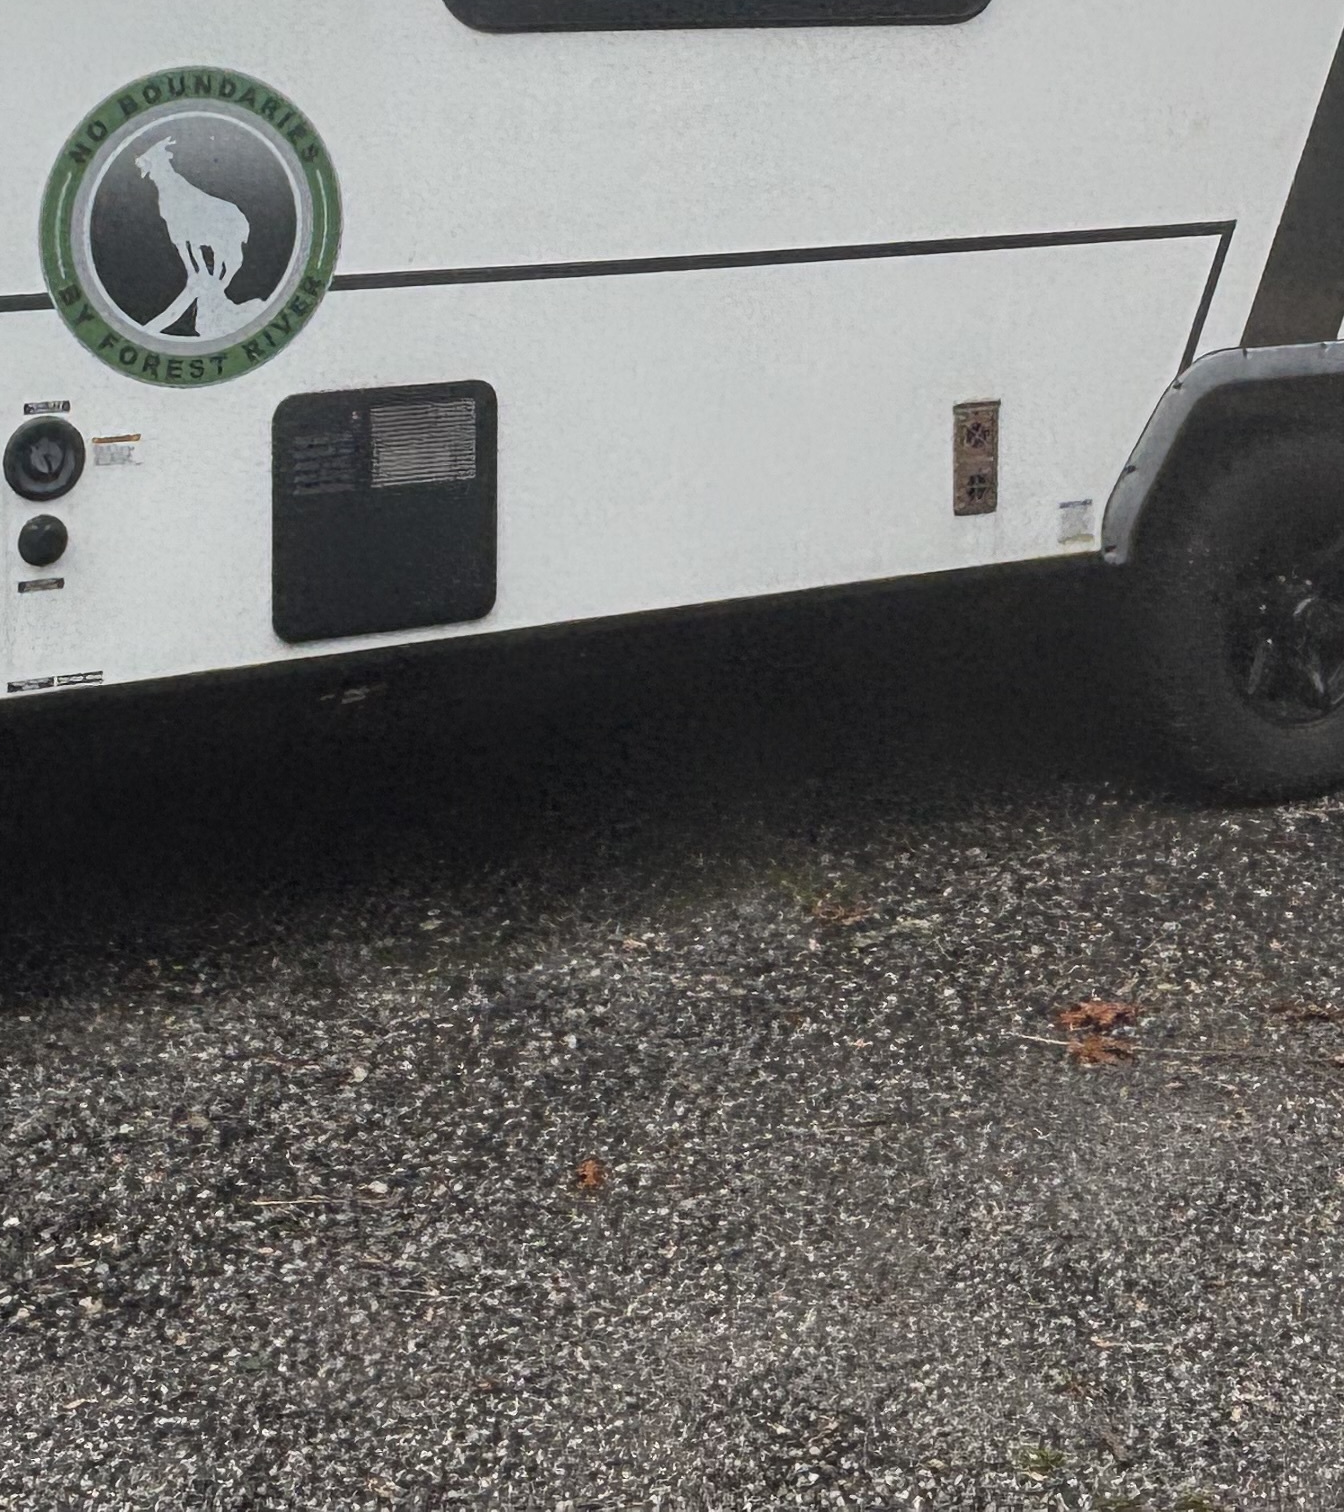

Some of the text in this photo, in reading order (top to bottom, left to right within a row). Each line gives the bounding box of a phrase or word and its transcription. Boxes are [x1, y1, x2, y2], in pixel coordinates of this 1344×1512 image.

[68, 74, 323, 164] NO BOUNDARIES
[57, 275, 322, 380] BY FOREST RIVER
